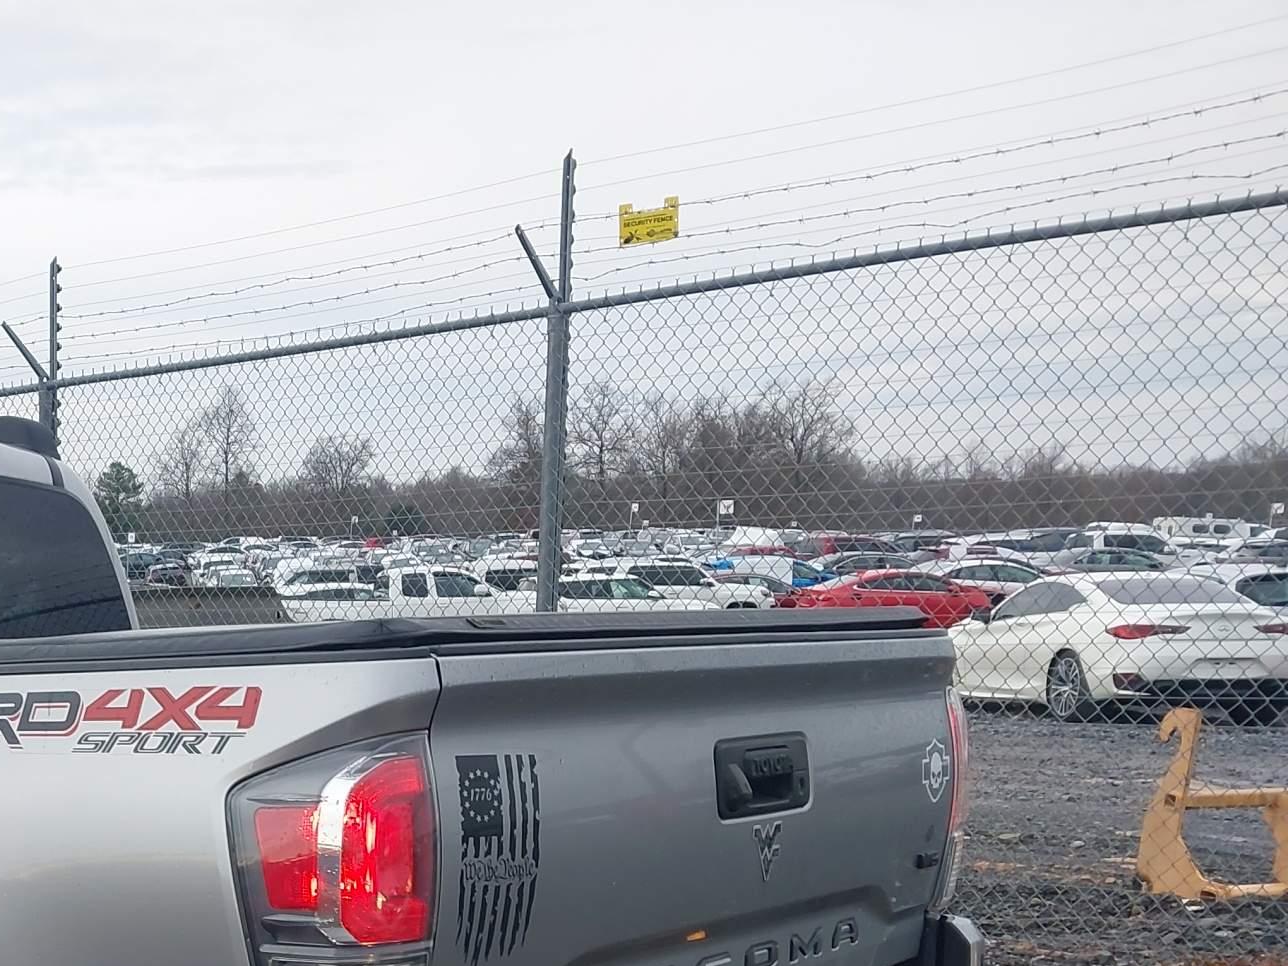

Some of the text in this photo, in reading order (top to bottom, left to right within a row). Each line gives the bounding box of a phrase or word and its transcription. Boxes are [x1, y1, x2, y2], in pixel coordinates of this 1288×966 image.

[623, 218, 653, 228] SECURITY
[653, 215, 674, 224] FENCE
[72, 732, 248, 755] SPORT
[470, 788, 493, 801] 1776
[464, 861, 482, 881] We
[497, 857, 535, 882] People
